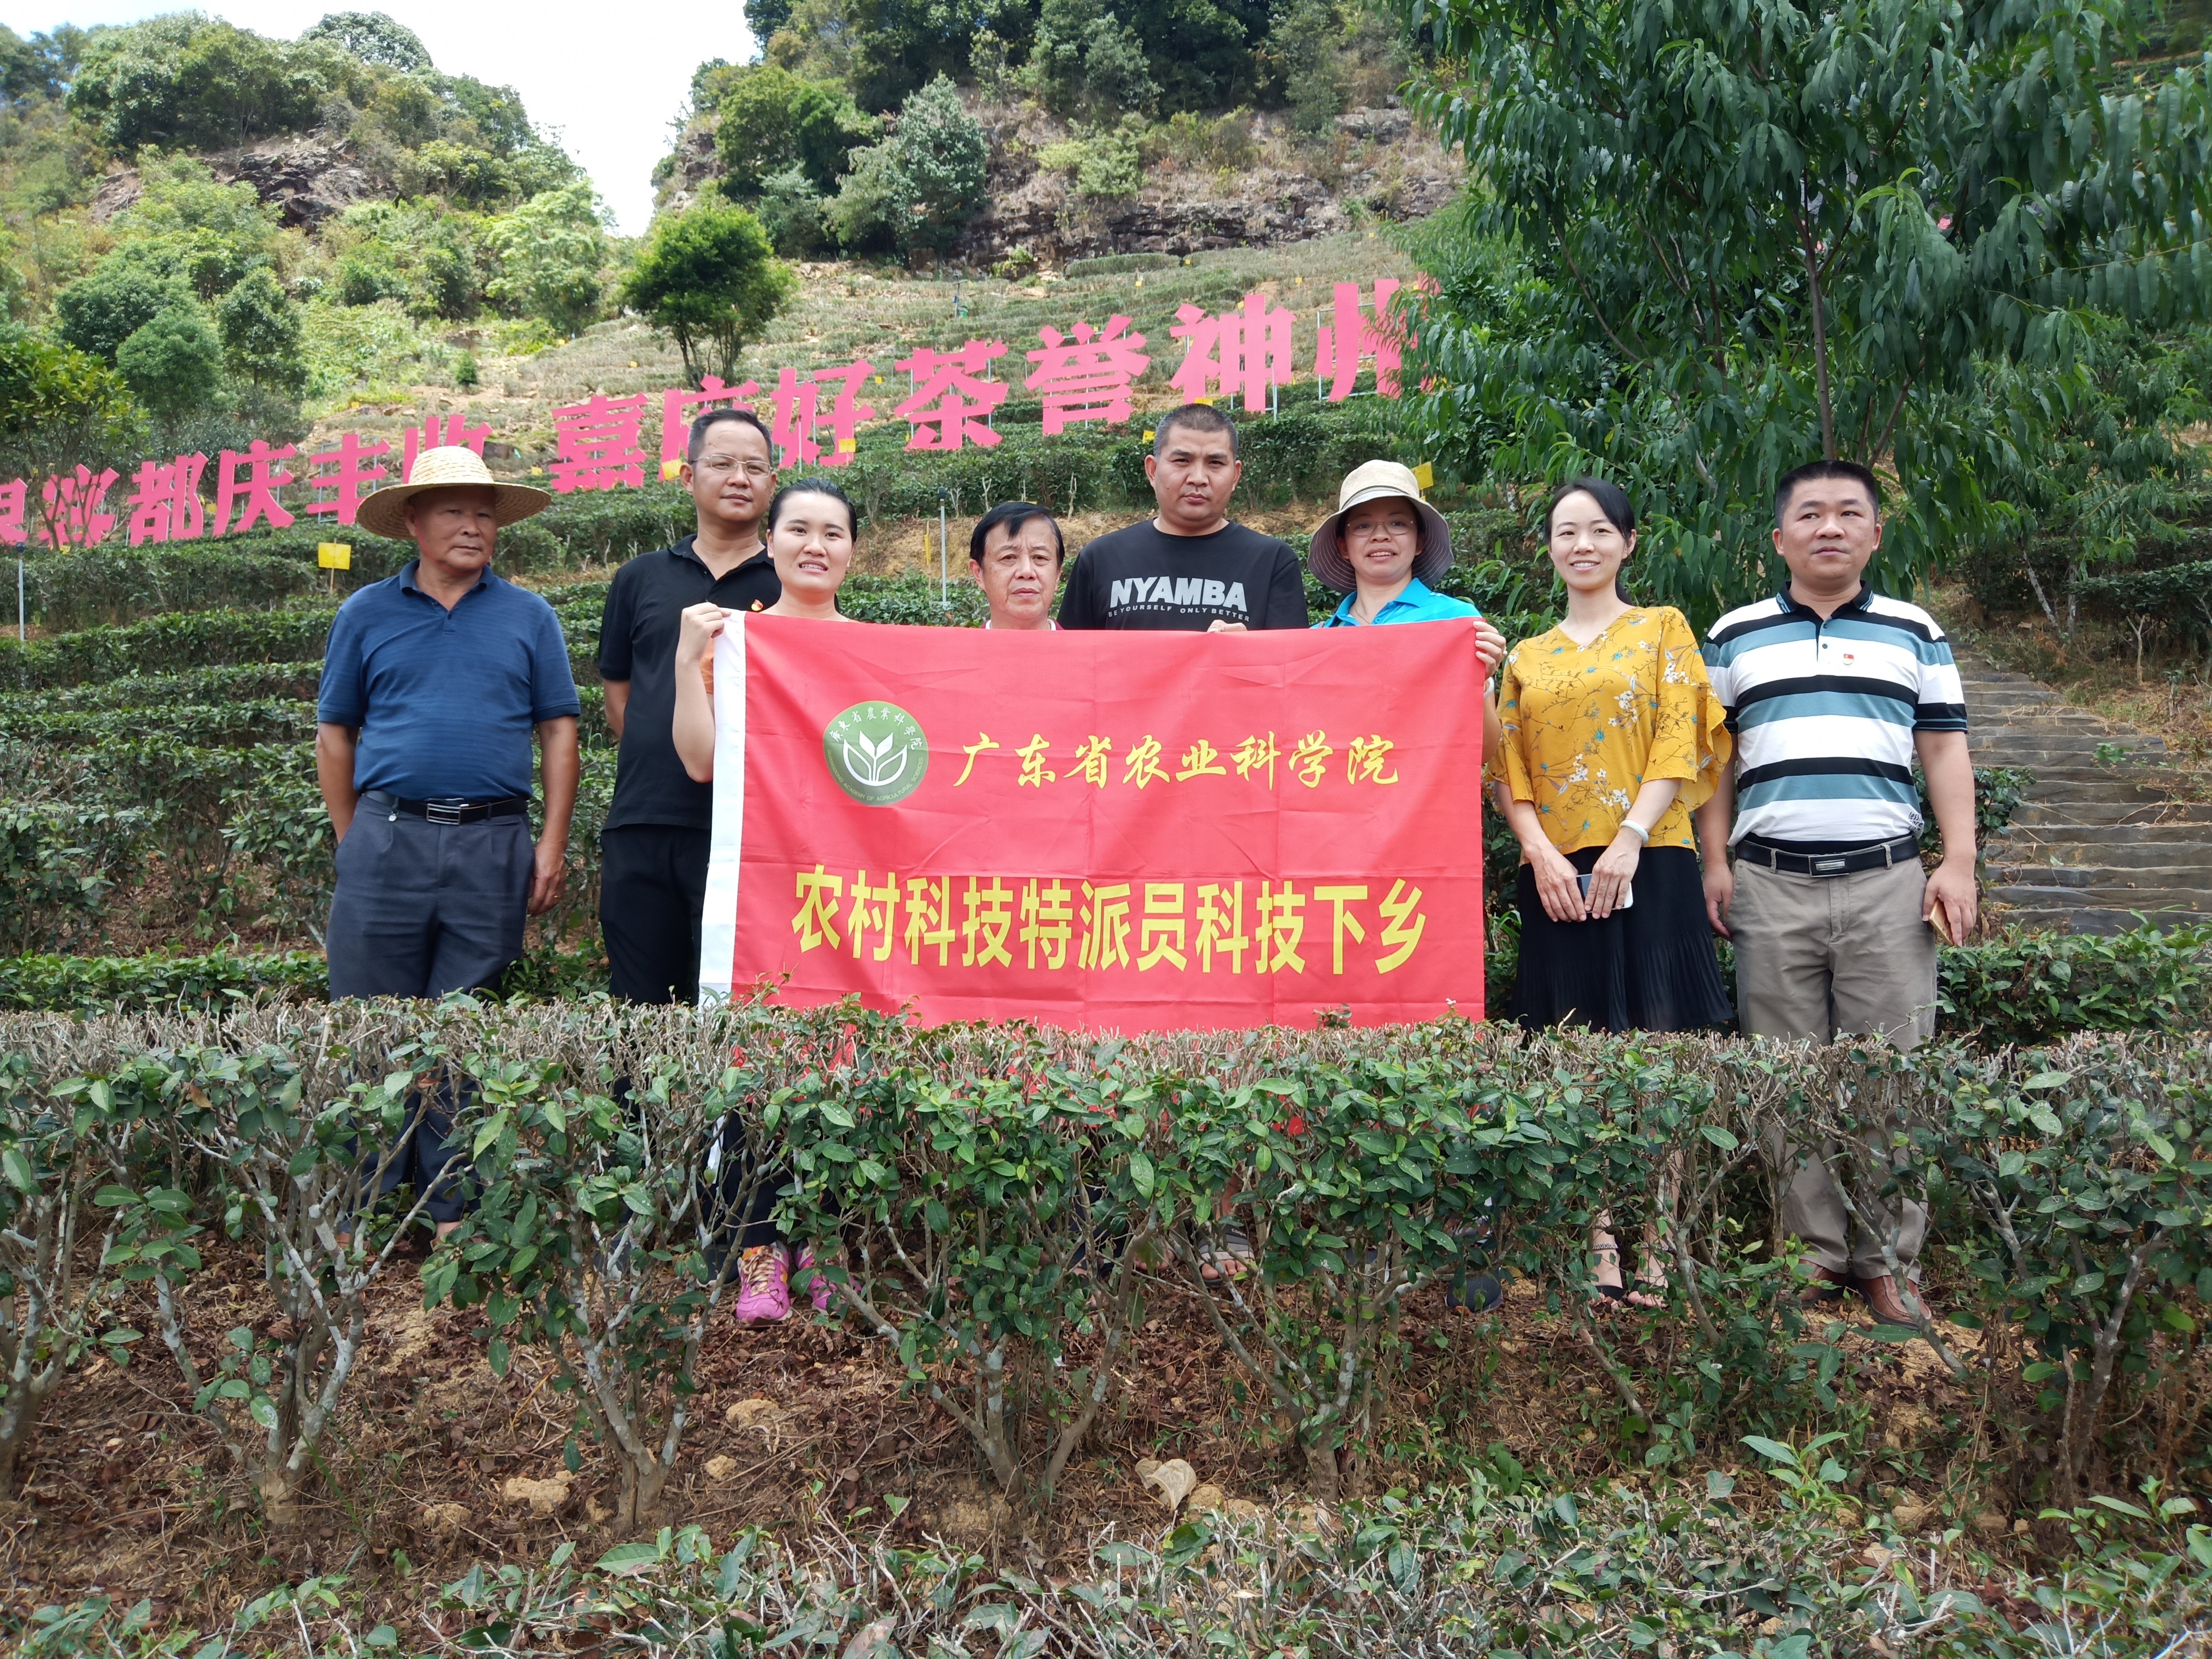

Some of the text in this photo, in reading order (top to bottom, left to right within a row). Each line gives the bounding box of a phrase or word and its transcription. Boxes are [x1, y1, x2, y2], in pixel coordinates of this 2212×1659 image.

[1108, 610, 1118, 618] BE
[1120, 604, 1172, 613] YOURSELF
[1211, 608, 1250, 622] BETTER
[1110, 576, 1248, 612] NYAMBA
[827, 749, 843, 783] GUANGDONG
[843, 782, 866, 799] ACADEMY
[876, 782, 914, 802] AGRICULTURAL
[911, 757, 924, 783] SCIENCES
[953, 730, 1400, 791] 广东省农业科学院
[791, 864, 1428, 976] 农村科技特派员科技下乡
